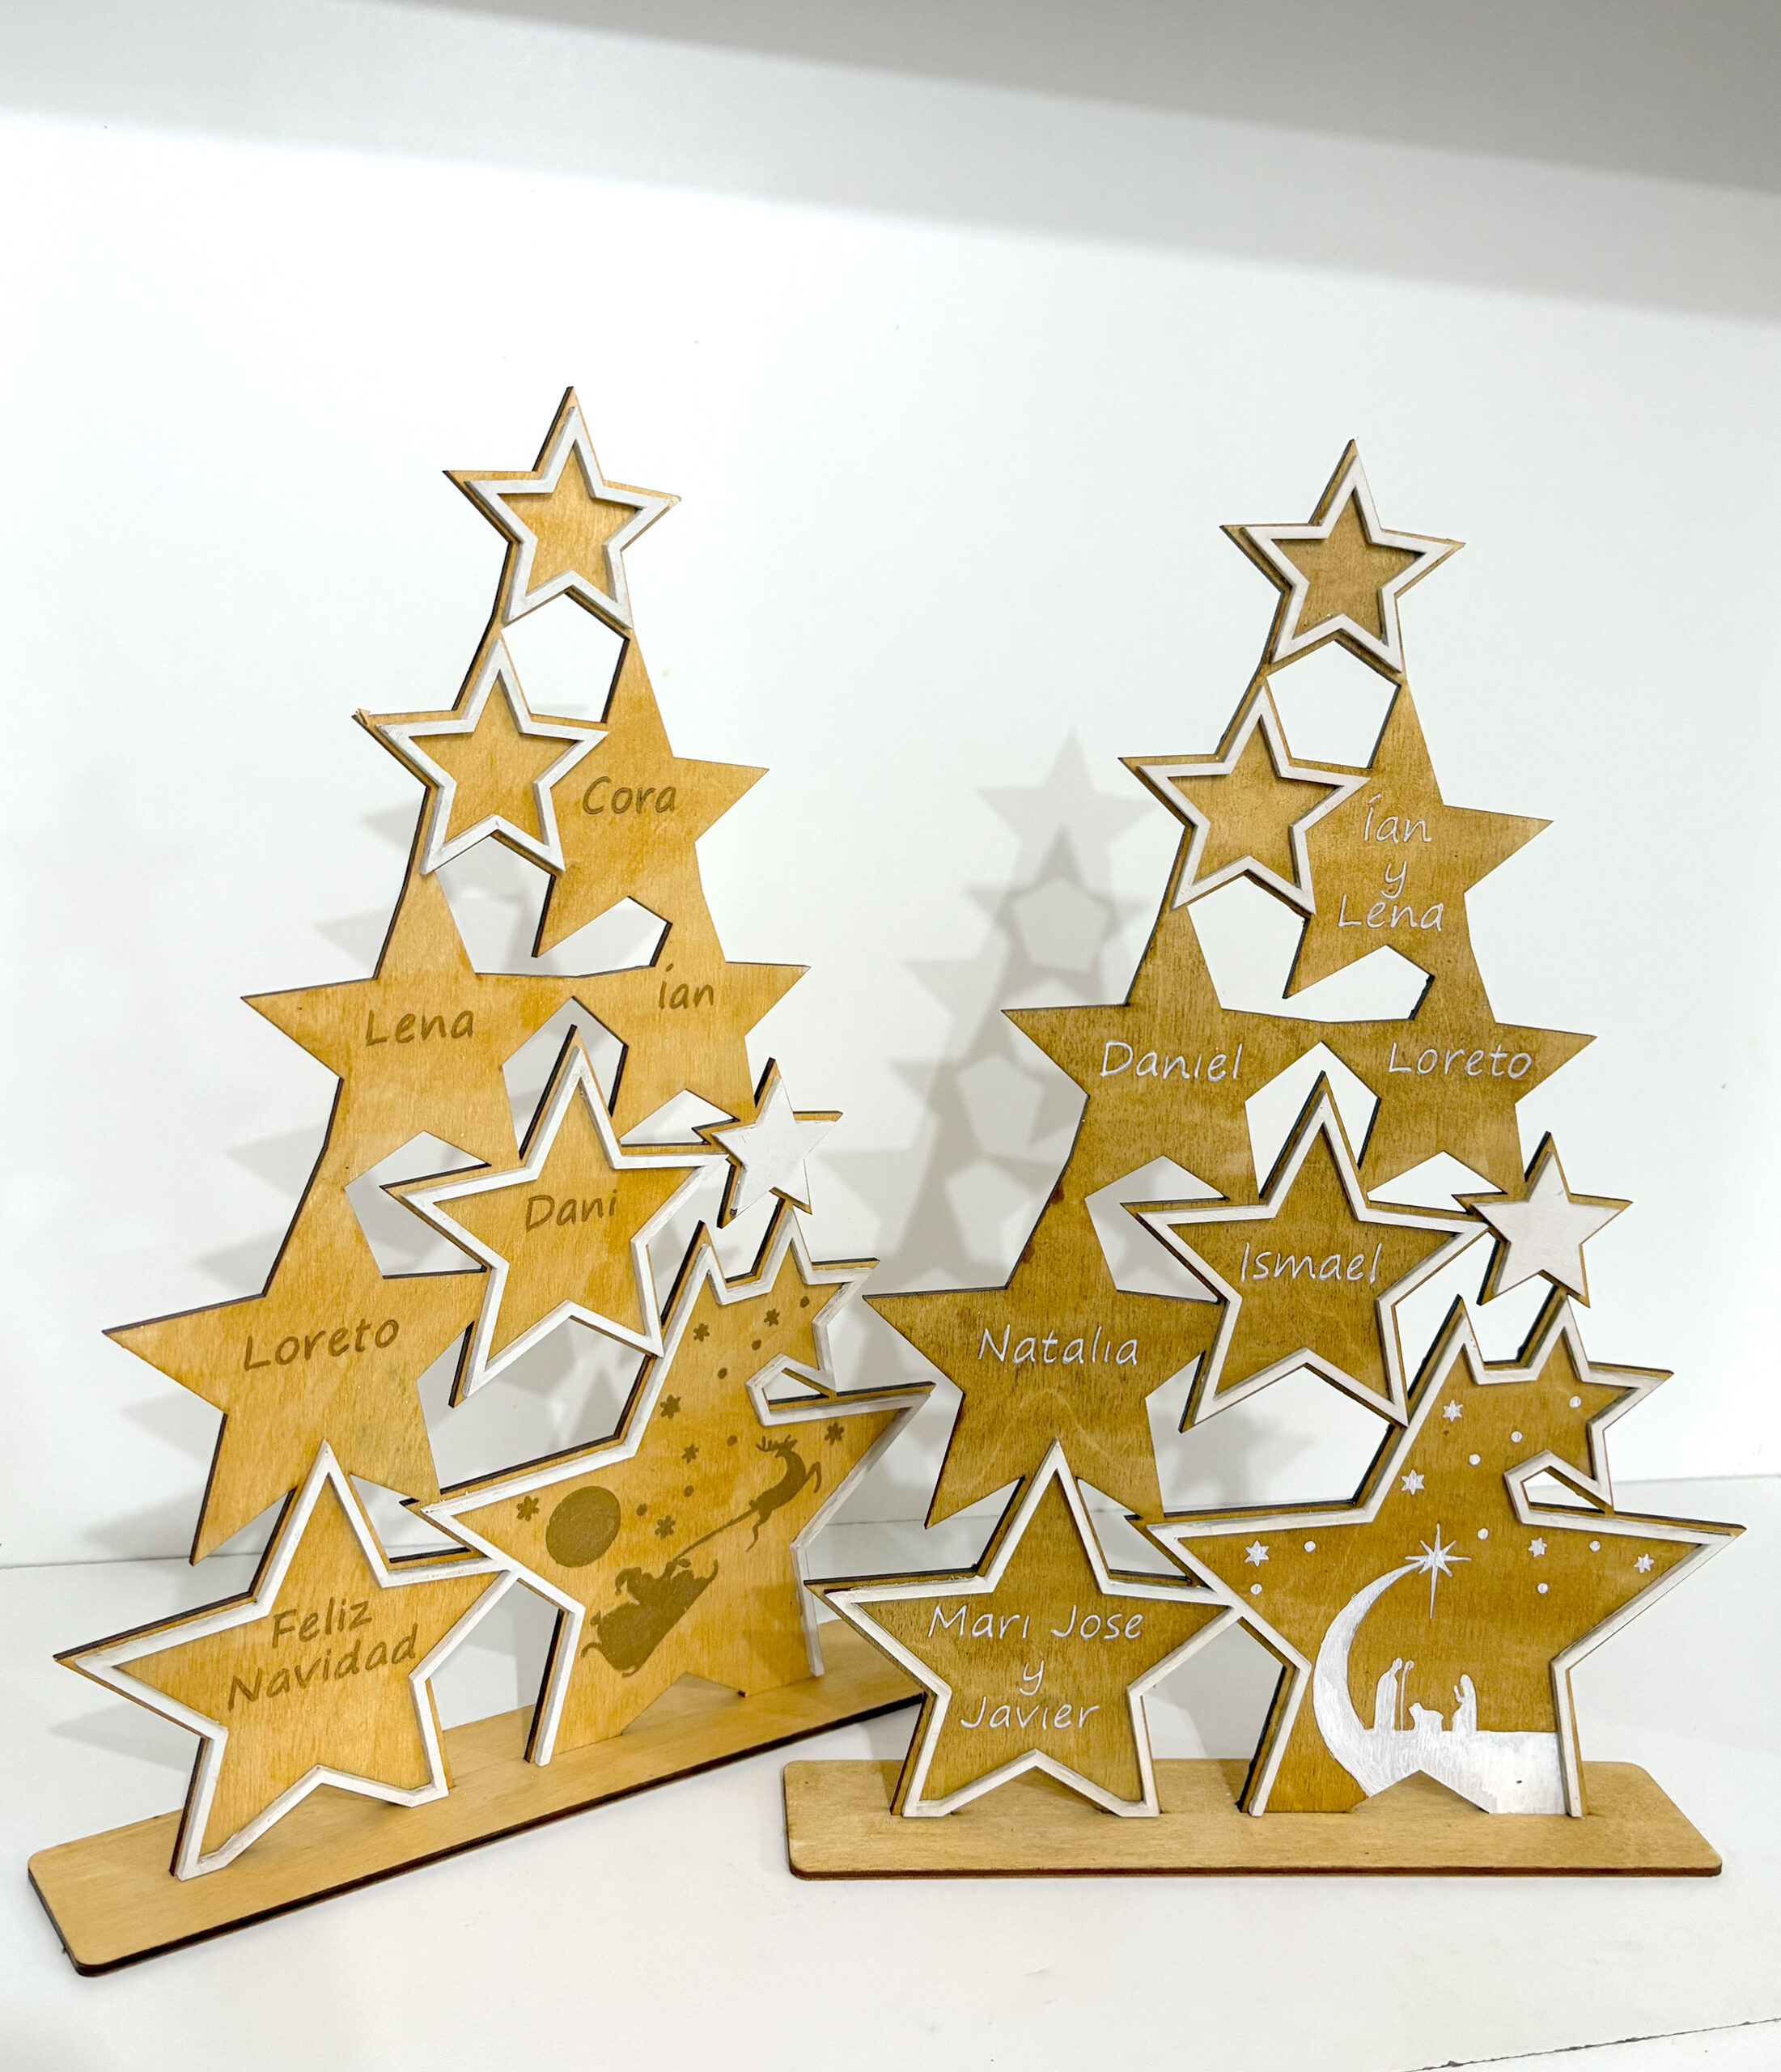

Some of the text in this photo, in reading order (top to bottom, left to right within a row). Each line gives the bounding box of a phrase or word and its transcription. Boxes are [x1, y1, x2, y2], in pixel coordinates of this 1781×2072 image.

[582, 775, 676, 815] Cora
[1380, 860, 1408, 899] y
[1338, 895, 1444, 932] Lena
[365, 1009, 475, 1047] Lena
[1100, 1040, 1243, 1082] Daniel
[1389, 1042, 1533, 1079] Loreto
[525, 1189, 618, 1233] Dani
[1240, 1242, 1383, 1284] Ismael
[243, 1318, 400, 1372] Loreto
[978, 1323, 1139, 1366] Natalia
[271, 1596, 372, 1649] Feliz
[928, 1603, 1143, 1640] Mari Jose
[227, 1622, 419, 1710] Navidad
[1019, 1660, 1045, 1696] y
[960, 1696, 1100, 1730] Javier
